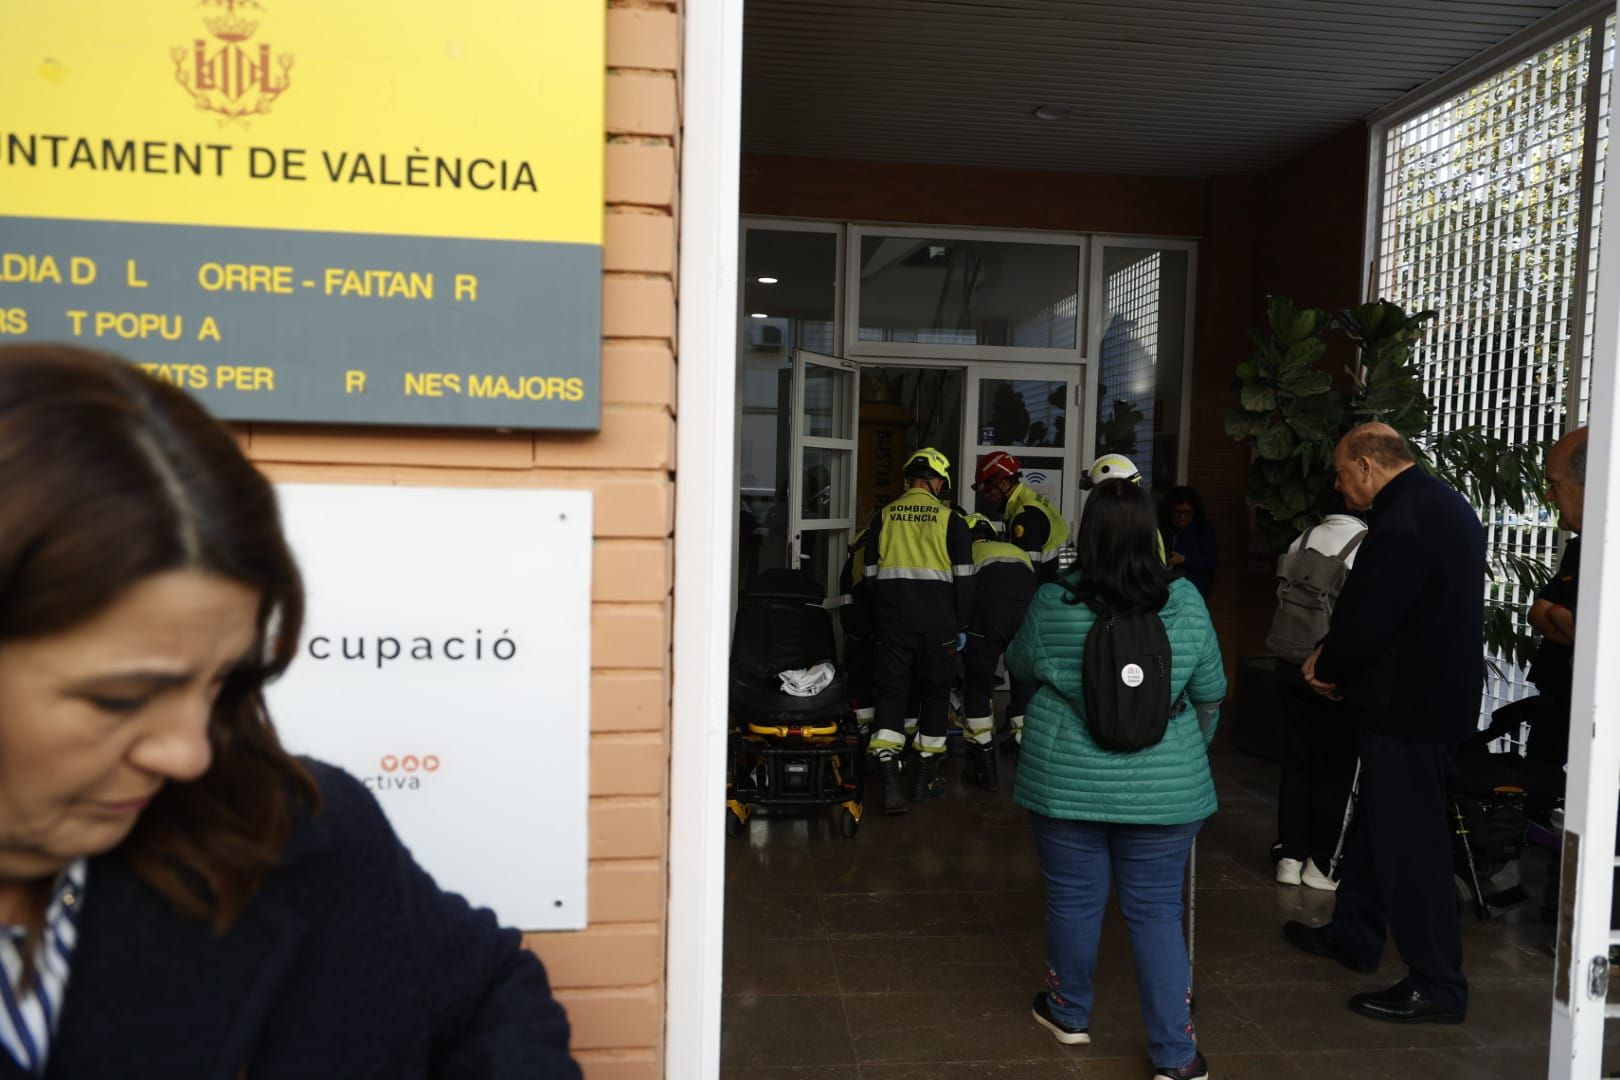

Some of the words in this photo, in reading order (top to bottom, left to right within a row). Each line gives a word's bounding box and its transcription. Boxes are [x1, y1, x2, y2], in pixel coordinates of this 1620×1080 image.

[0, 132, 233, 177] NTAMENT
[248, 146, 307, 181] DE
[321, 146, 538, 193] VALÈNCIA
[0, 252, 62, 285] DIA
[198, 262, 294, 293] ORRE
[216, 365, 275, 391] PER
[468, 373, 584, 402] MAJORS
[890, 504, 939, 514] BOMBERS
[308, 628, 518, 669] cupació
